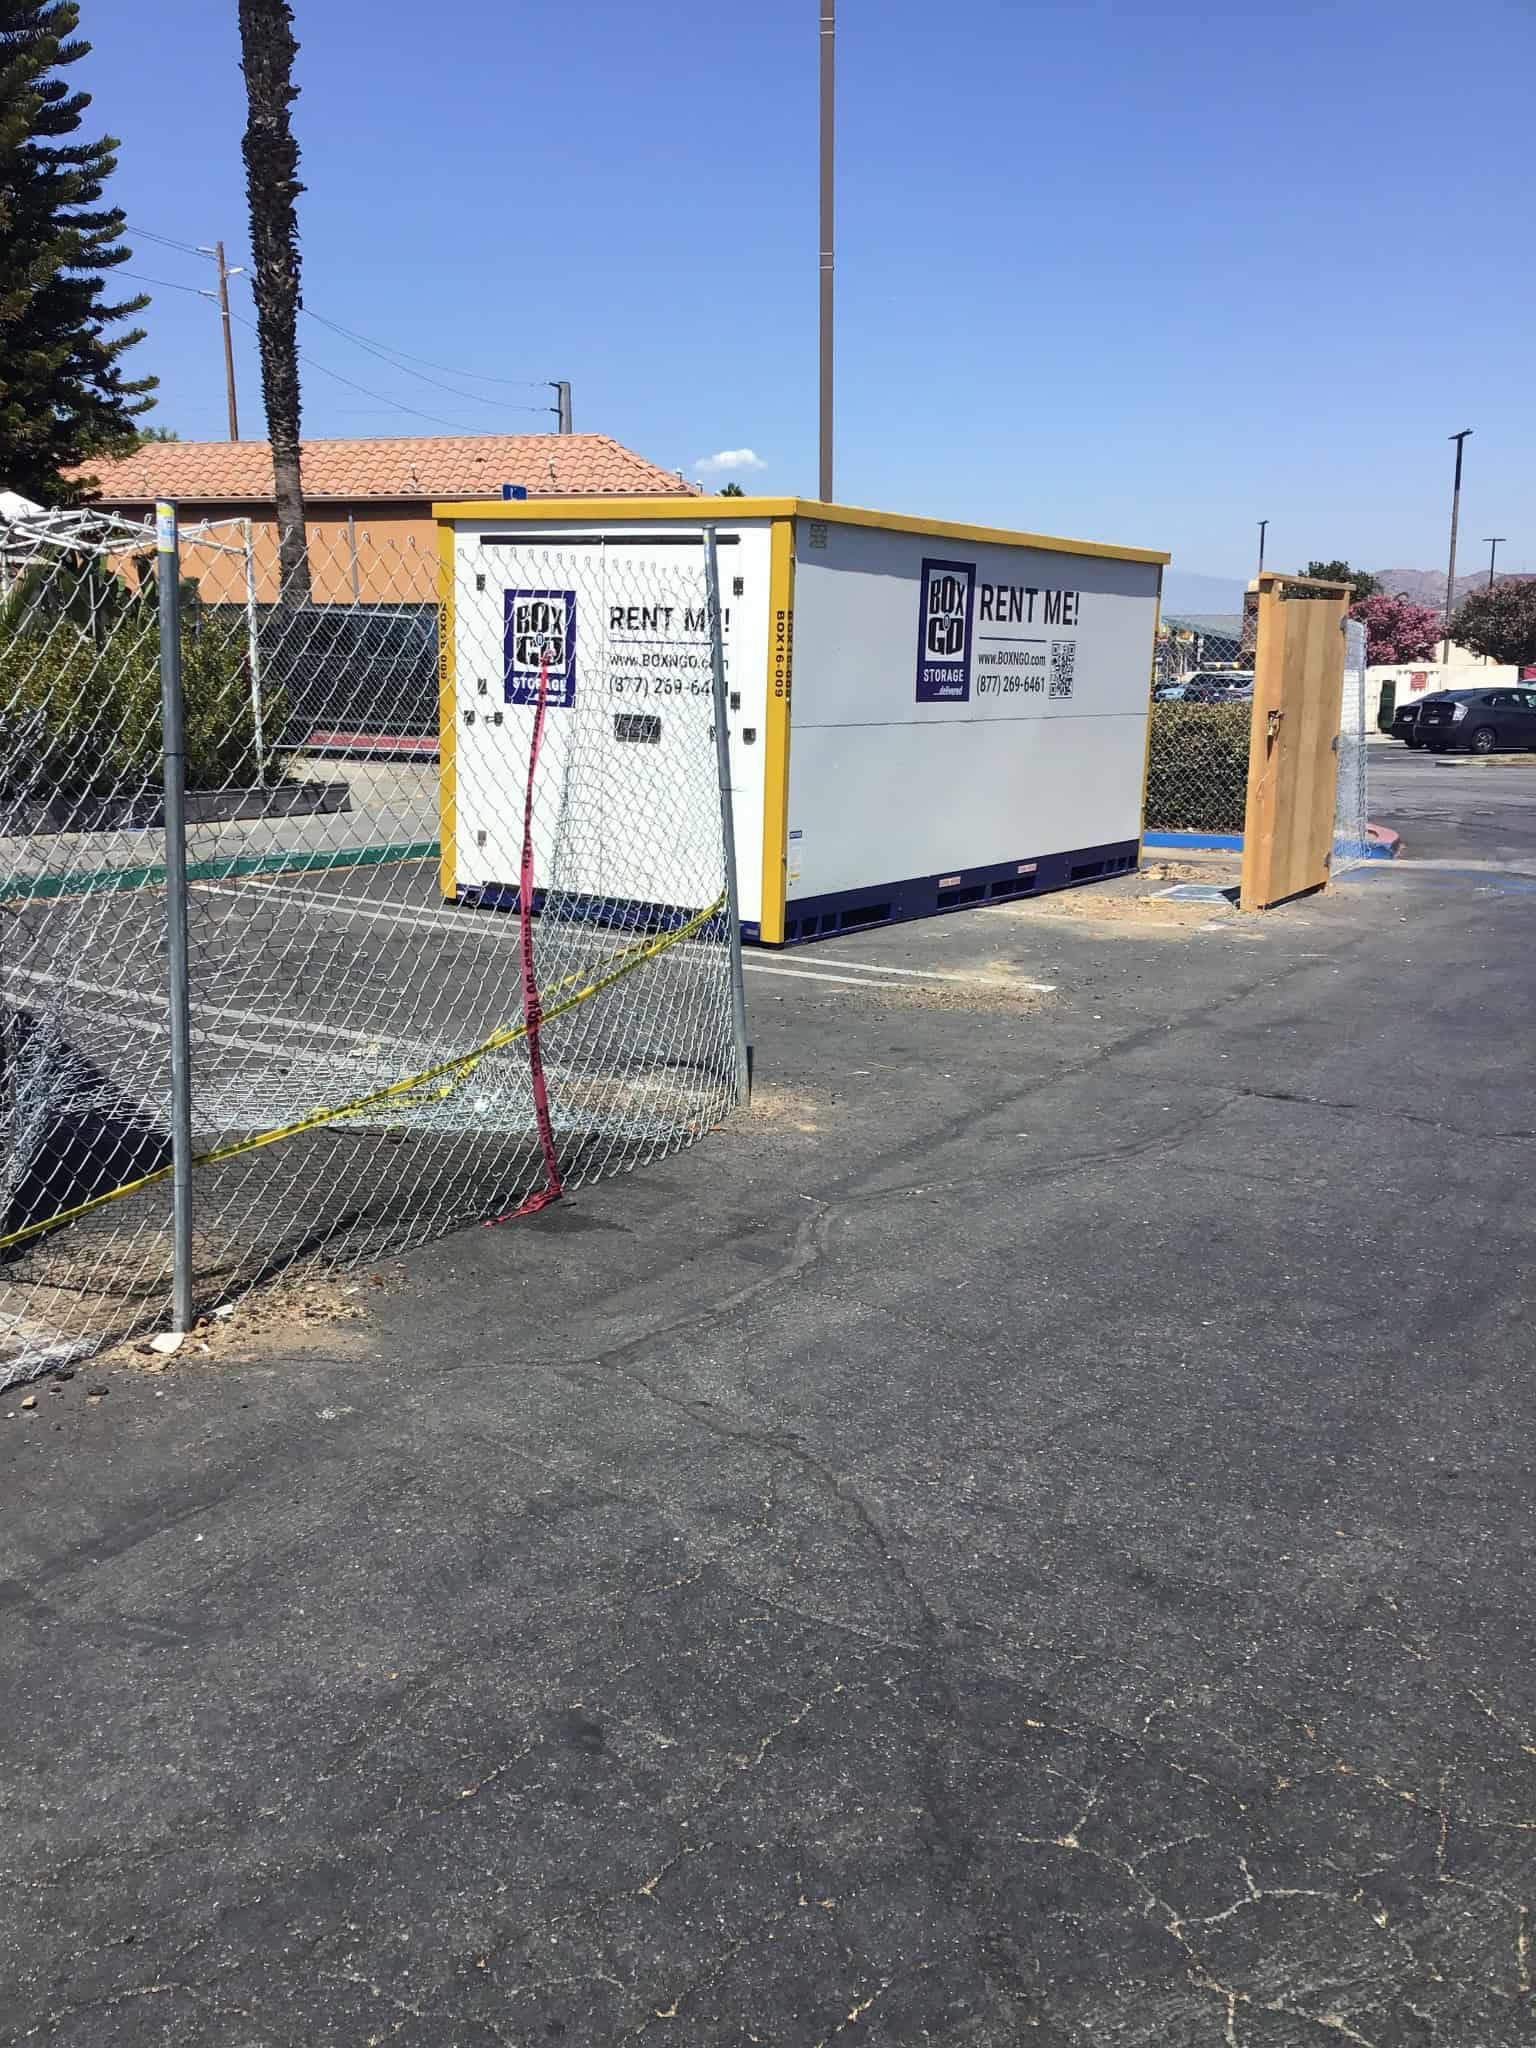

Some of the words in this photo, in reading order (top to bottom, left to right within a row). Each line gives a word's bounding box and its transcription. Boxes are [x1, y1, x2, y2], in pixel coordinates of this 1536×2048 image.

[929, 576, 965, 616] BOX
[980, 584, 1038, 623] RENT
[1044, 589, 1080, 626] ME!
[516, 602, 562, 635] BOX
[609, 606, 674, 631] RENT
[684, 607, 730, 632] M!
[516, 635, 564, 668] GO
[928, 617, 963, 655] GO
[775, 610, 785, 697] BOX16-009
[978, 651, 1046, 666] www.BOXNGO.com
[609, 675, 649, 698] (877)
[654, 678, 729, 697] 269-641
[923, 668, 964, 682] STORAGE
[976, 673, 1001, 696] (877)
[1003, 676, 1045, 692] 269-6461
